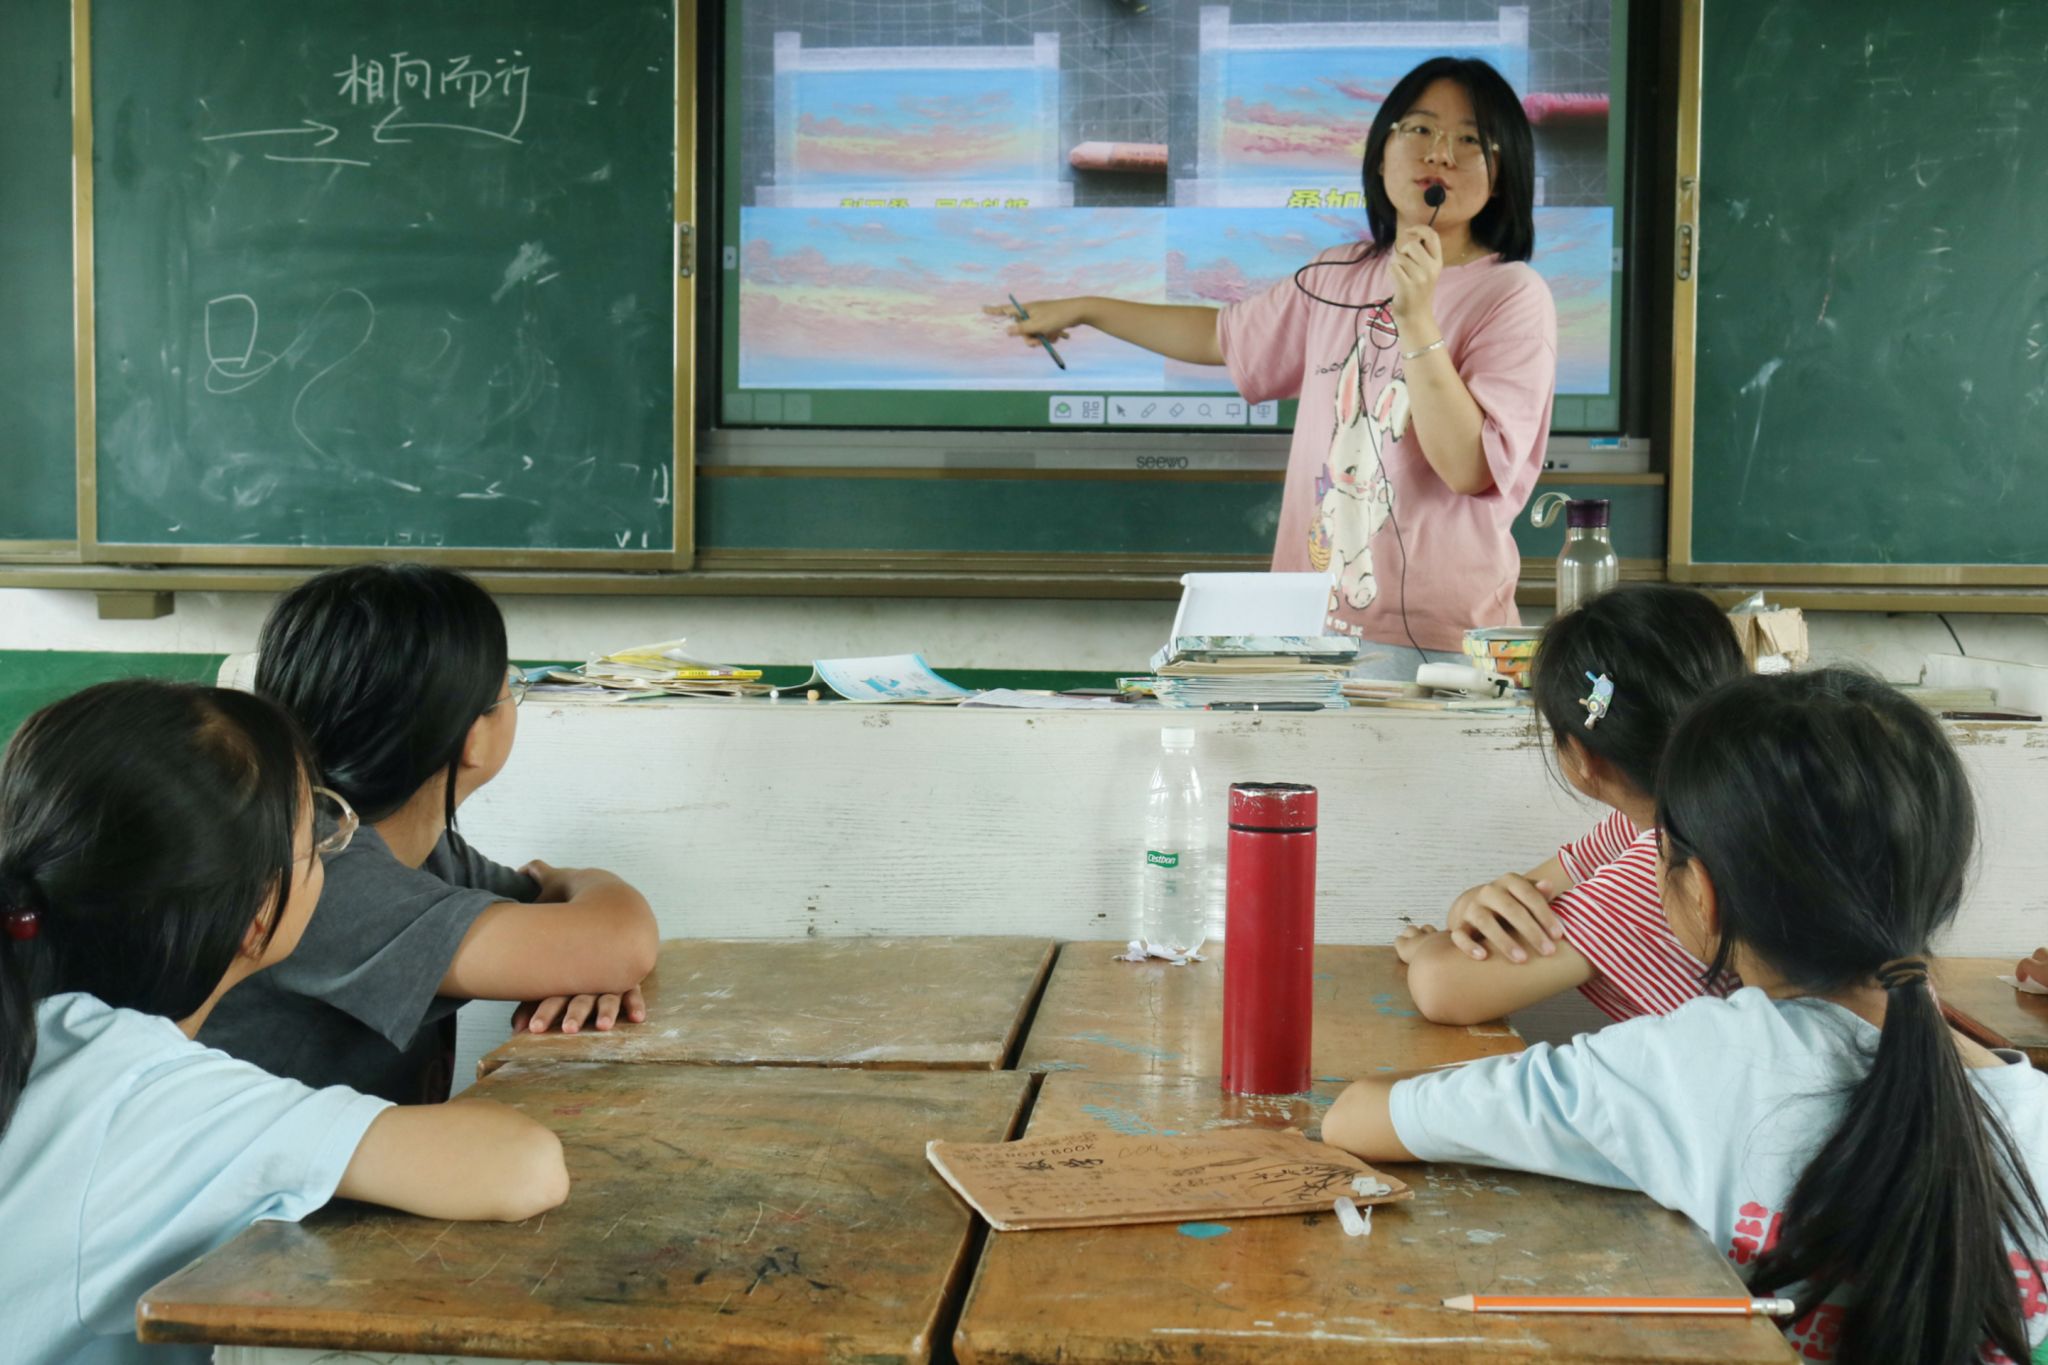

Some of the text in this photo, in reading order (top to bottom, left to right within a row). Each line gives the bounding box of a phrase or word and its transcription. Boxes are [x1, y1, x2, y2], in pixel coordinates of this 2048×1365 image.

[334, 50, 531, 138] 相向而行
[1287, 187, 1367, 208] 叠加
[1136, 455, 1189, 469] seewo
[1005, 1143, 1097, 1159] NOTEBOOK
